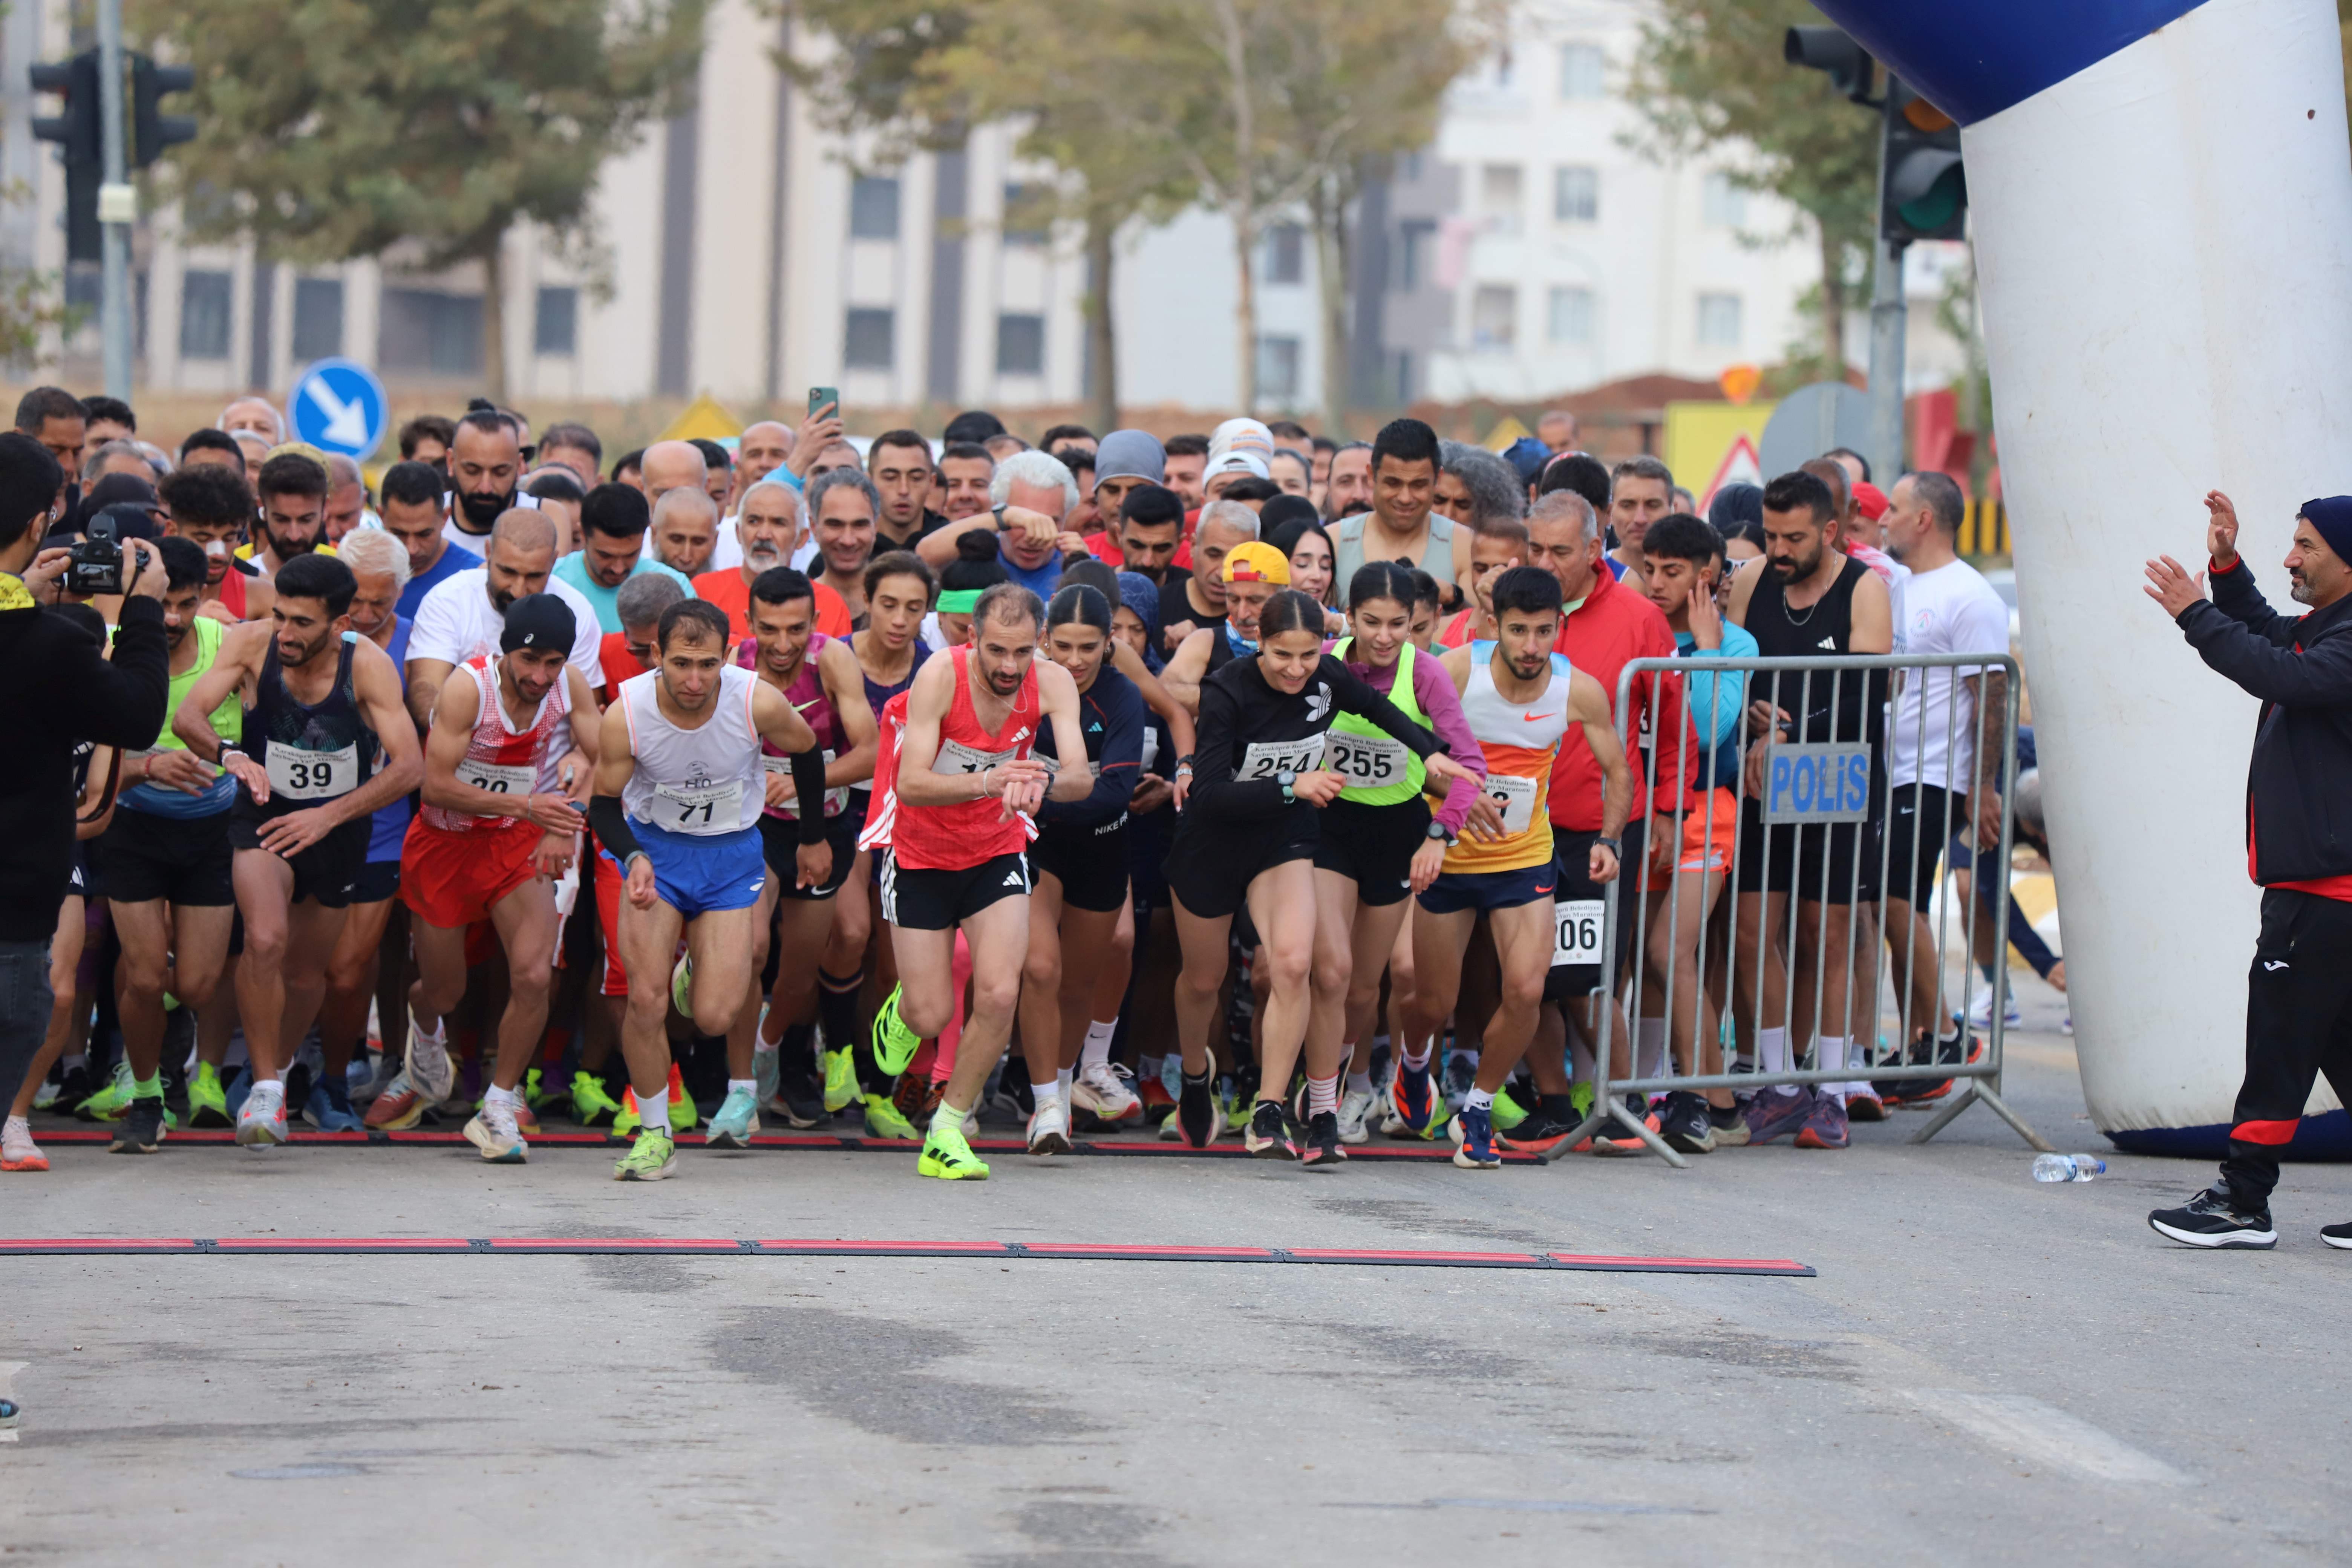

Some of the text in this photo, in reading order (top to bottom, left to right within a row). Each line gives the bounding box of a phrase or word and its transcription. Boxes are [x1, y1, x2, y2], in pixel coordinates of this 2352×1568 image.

[1256, 738, 1319, 752] Karaköprü Belediyesi
[1294, 745, 1321, 754] Maratonu
[1329, 732, 1399, 749] Karaköprü Belediyesi
[1251, 753, 1311, 778] 254
[1334, 746, 1392, 778] 255
[290, 763, 332, 789] 39
[678, 802, 713, 822] 71
[1095, 820, 1119, 836] NIKE
[1556, 918, 1597, 951] 06
